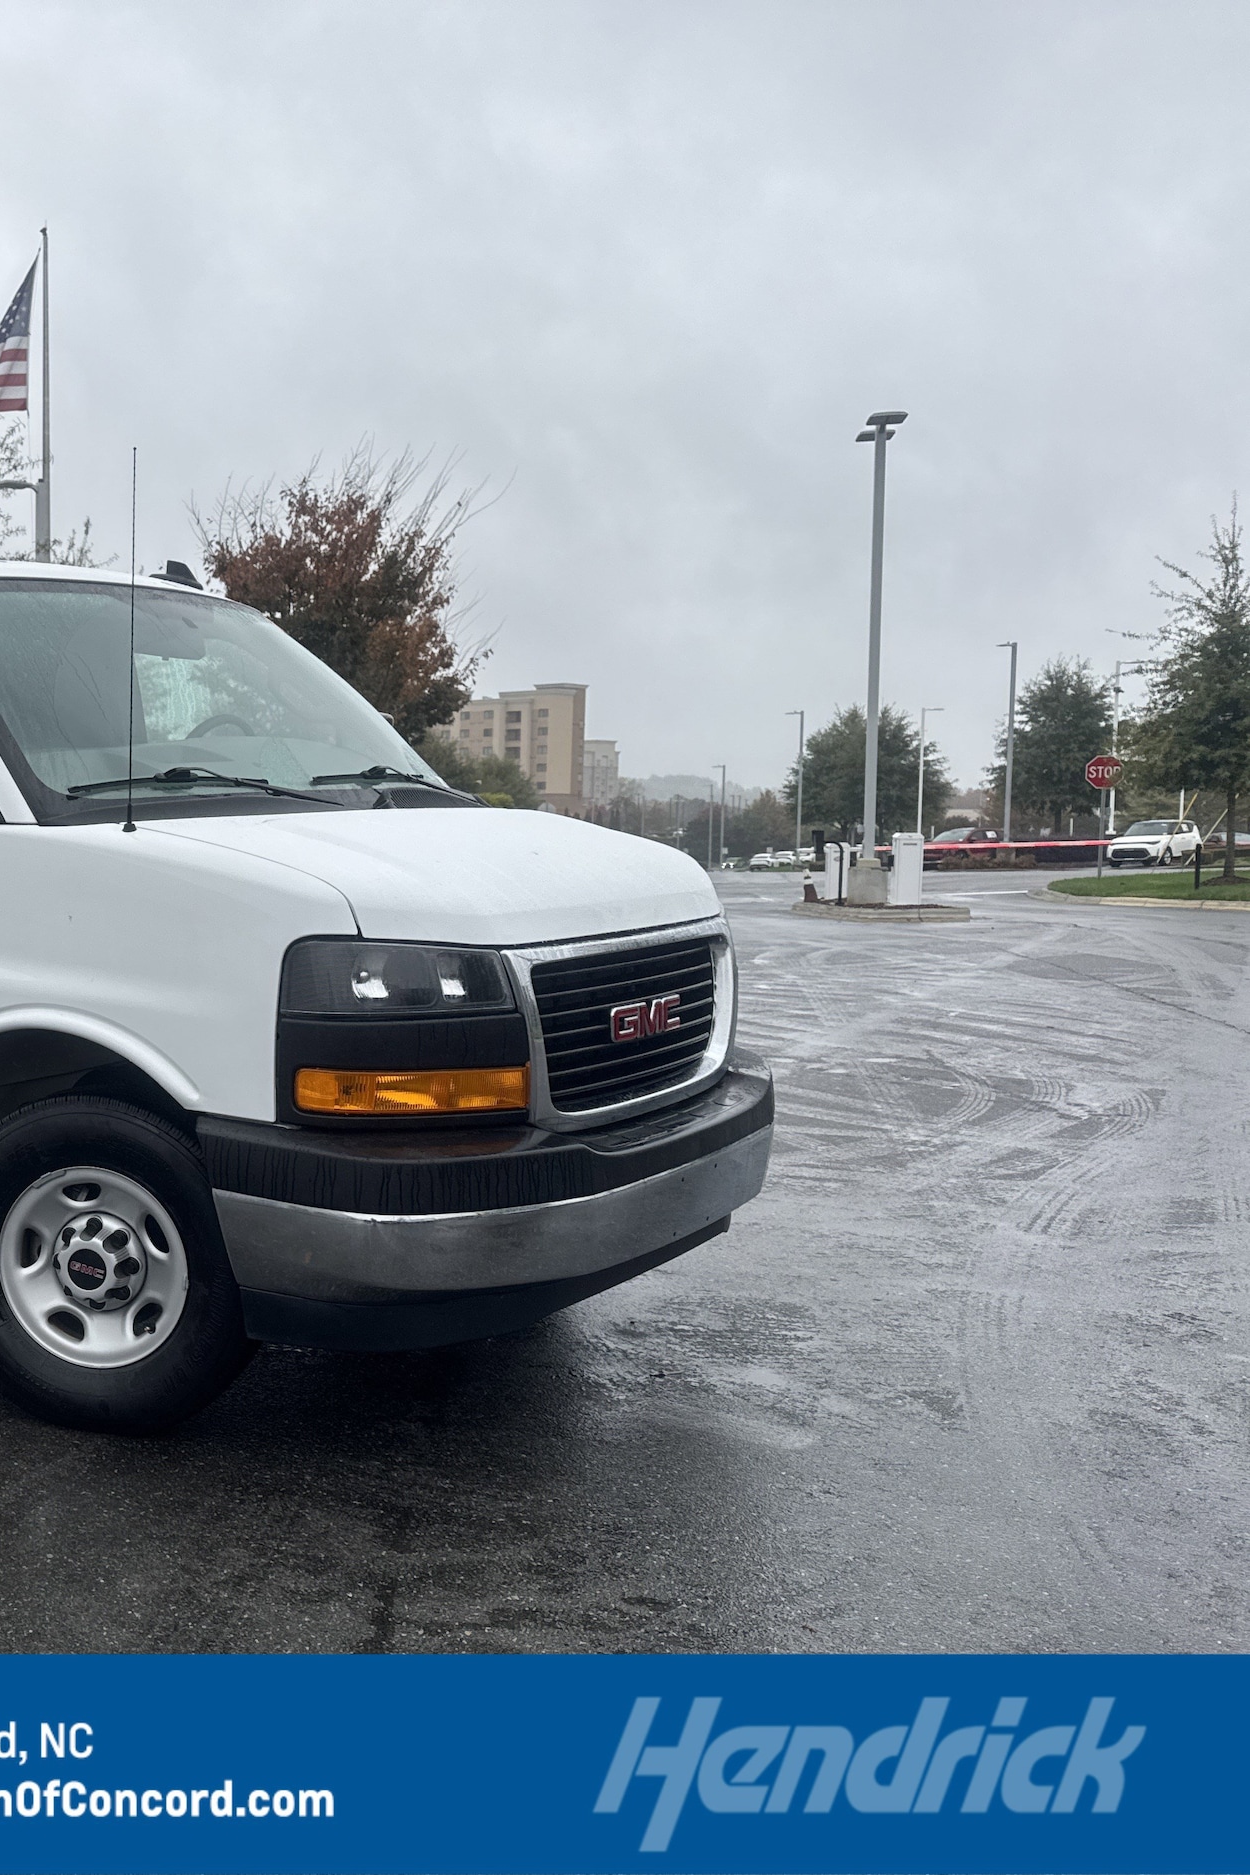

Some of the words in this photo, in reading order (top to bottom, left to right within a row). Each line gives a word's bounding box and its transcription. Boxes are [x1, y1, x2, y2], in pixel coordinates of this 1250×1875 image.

[1088, 766, 1122, 779] STOP
[611, 994, 681, 1042] GMC
[69, 1260, 105, 1280] GMC
